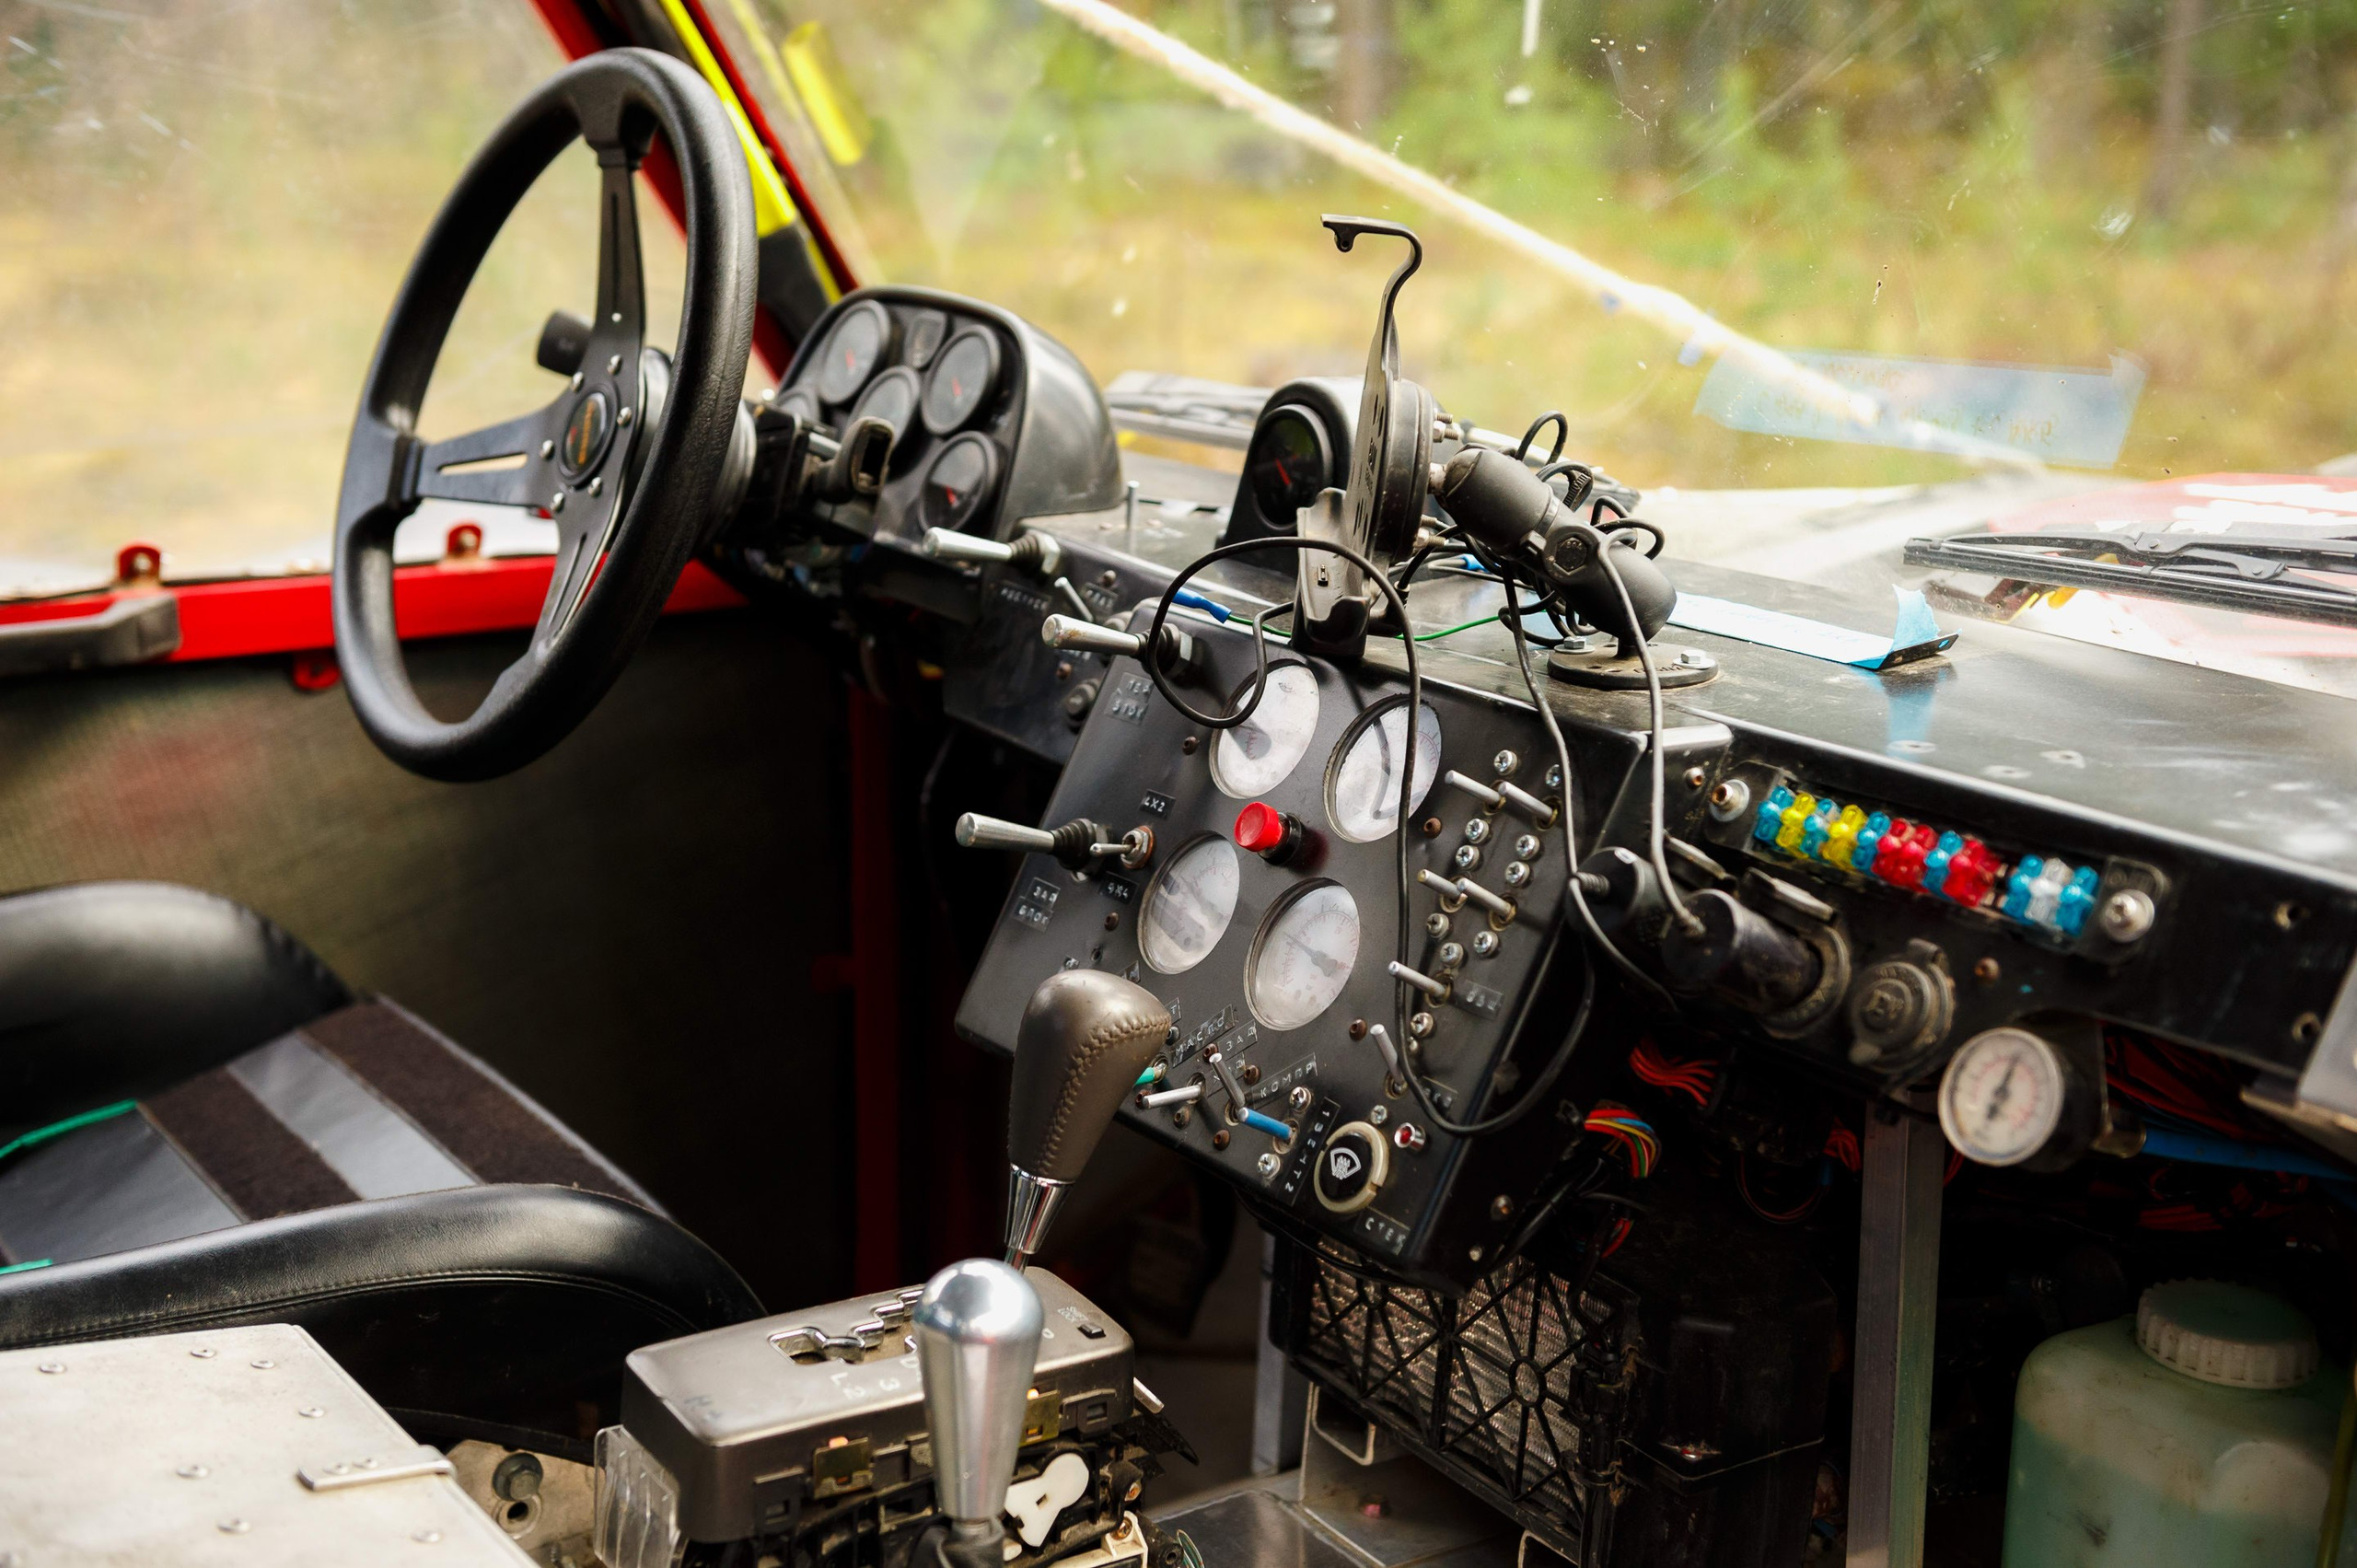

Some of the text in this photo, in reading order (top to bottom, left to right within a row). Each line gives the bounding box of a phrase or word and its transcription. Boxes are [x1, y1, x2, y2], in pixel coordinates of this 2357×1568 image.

[1225, 1026, 1256, 1051] ЗАД
[1213, 1059, 1245, 1085] ХД
[1260, 1061, 1315, 1098] КОМПР
[830, 1372, 849, 1387] L
[879, 1377, 900, 1392] 3
